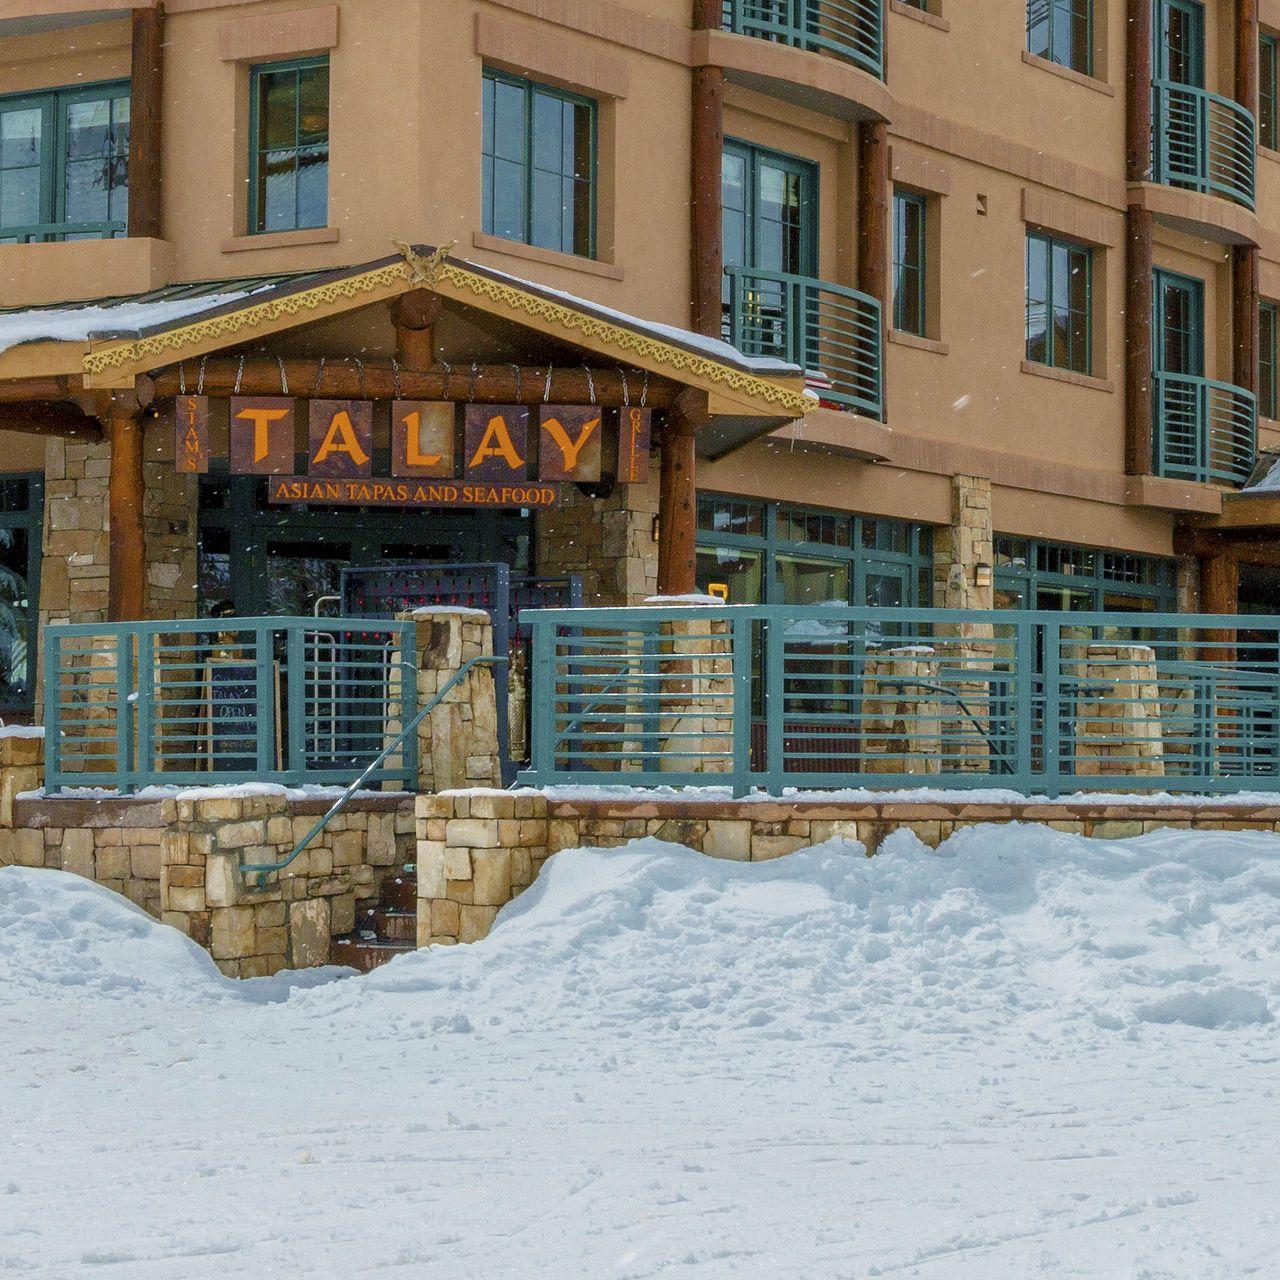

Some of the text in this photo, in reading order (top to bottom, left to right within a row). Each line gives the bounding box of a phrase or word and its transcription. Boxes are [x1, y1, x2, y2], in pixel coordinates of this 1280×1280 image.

[185, 397, 203, 471] SIAM'S
[235, 407, 600, 473] TALAY
[275, 482, 555, 504] ASIAN TAPAS AND SEAFOOD
